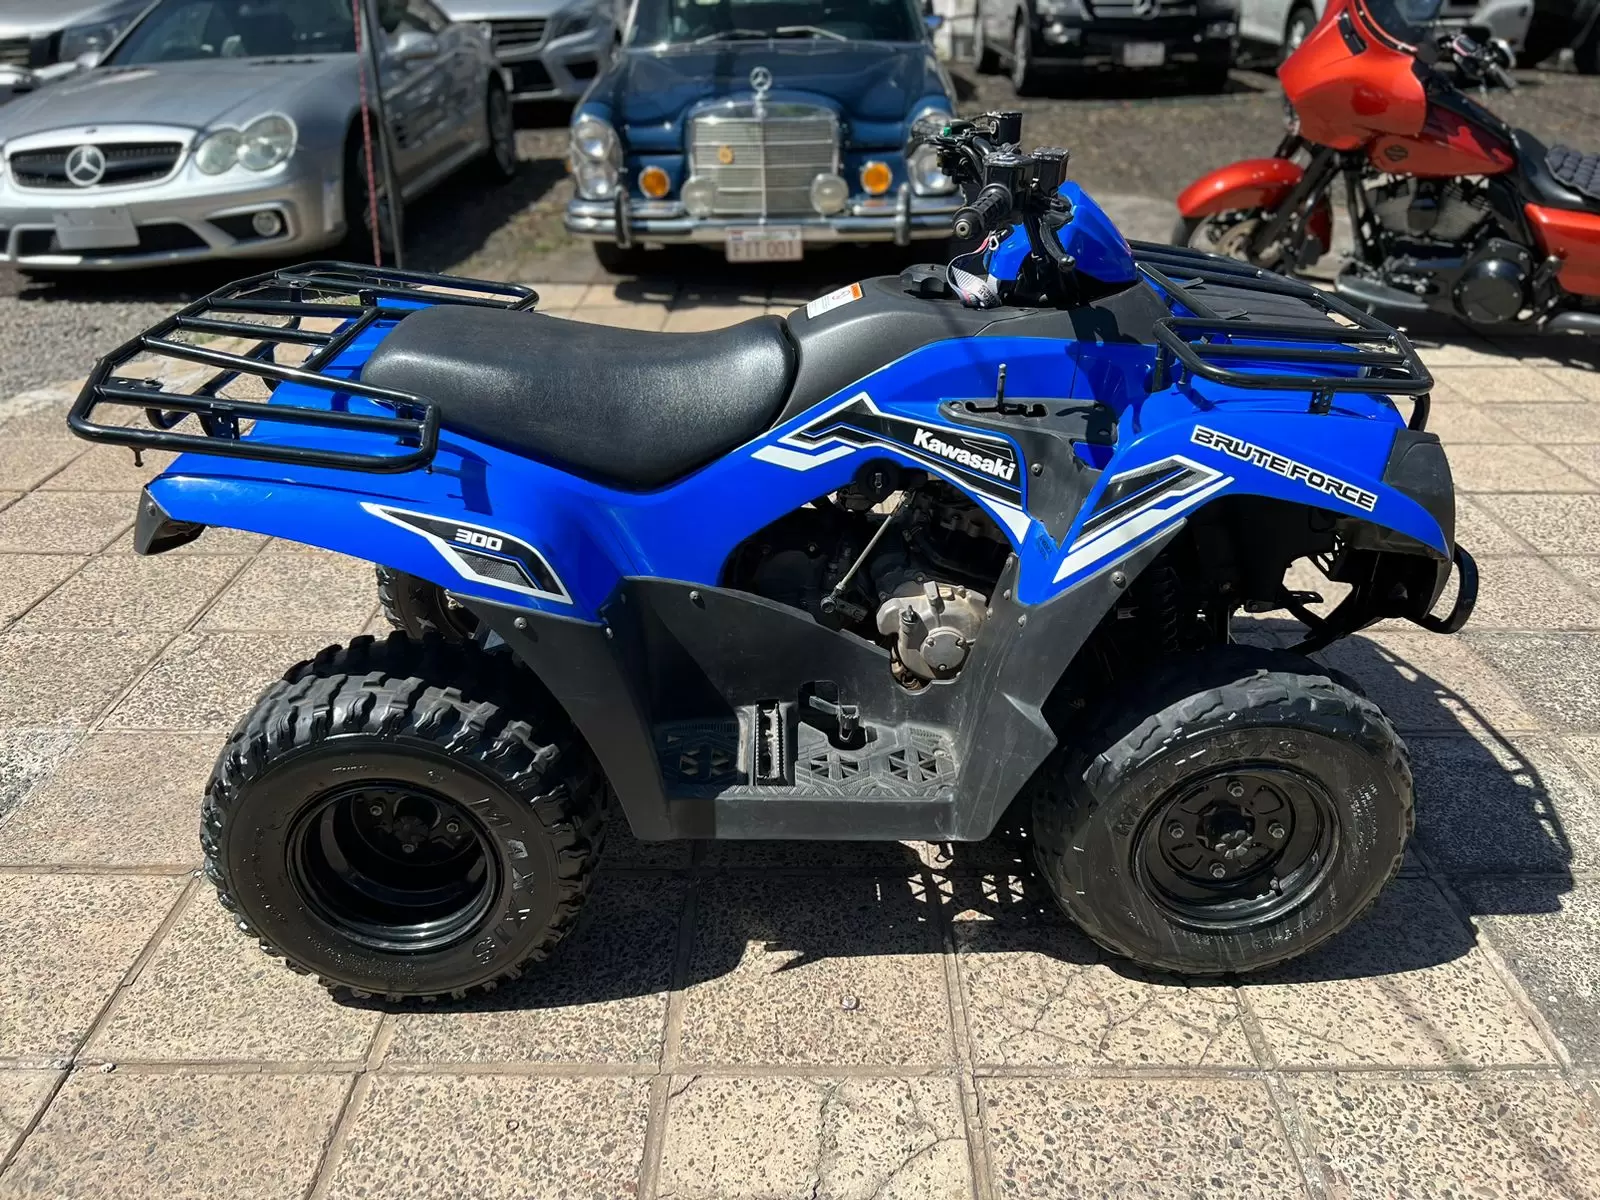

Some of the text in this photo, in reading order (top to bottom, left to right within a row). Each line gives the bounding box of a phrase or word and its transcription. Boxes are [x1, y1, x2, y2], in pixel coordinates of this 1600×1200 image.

[767, 240, 794, 257] 001
[913, 428, 1016, 480] Kawasaki
[1191, 425, 1377, 511] BRUTE FORCE
[455, 529, 502, 551] 300
[467, 797, 535, 965] MAXXIS
